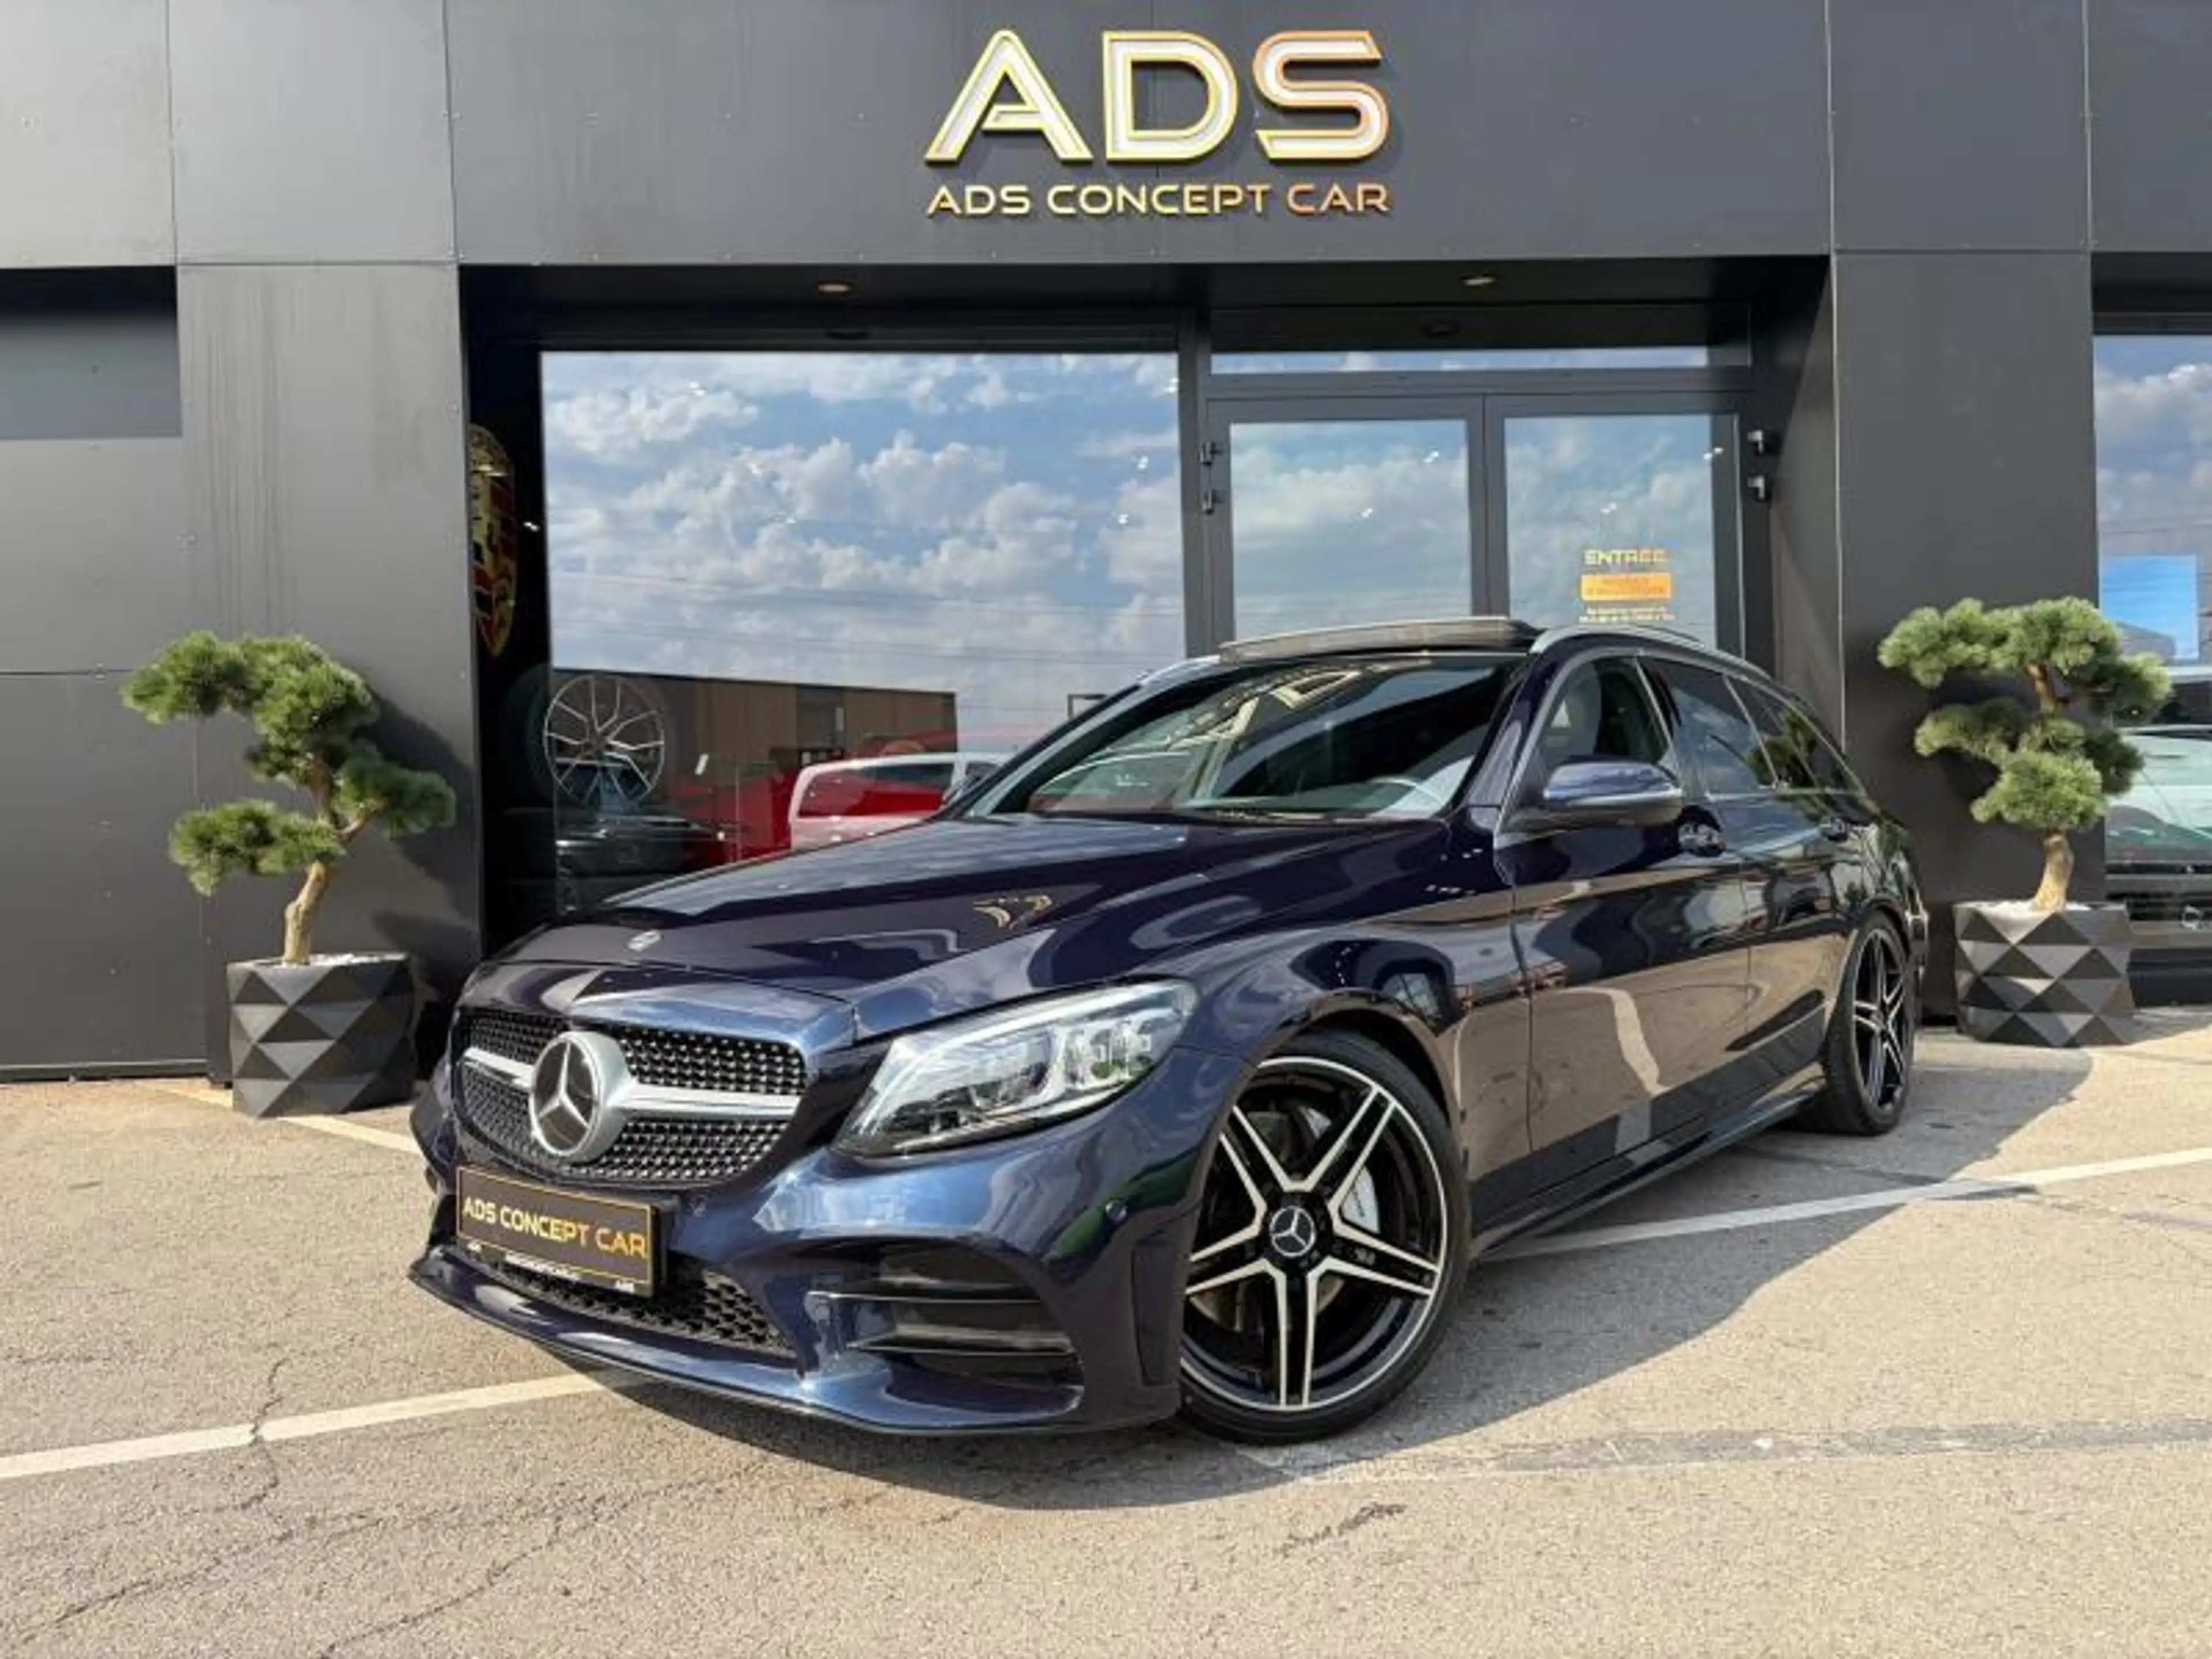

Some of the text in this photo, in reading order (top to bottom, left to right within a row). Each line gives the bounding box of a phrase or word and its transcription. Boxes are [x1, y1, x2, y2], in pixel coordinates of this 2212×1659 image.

[924, 29, 1389, 161] ADS
[926, 183, 1390, 215] ADS CONCEPT CAR
[463, 1196, 495, 1224] ADS
[499, 1205, 590, 1247] CONCEPT
[594, 1228, 646, 1259] CAR
